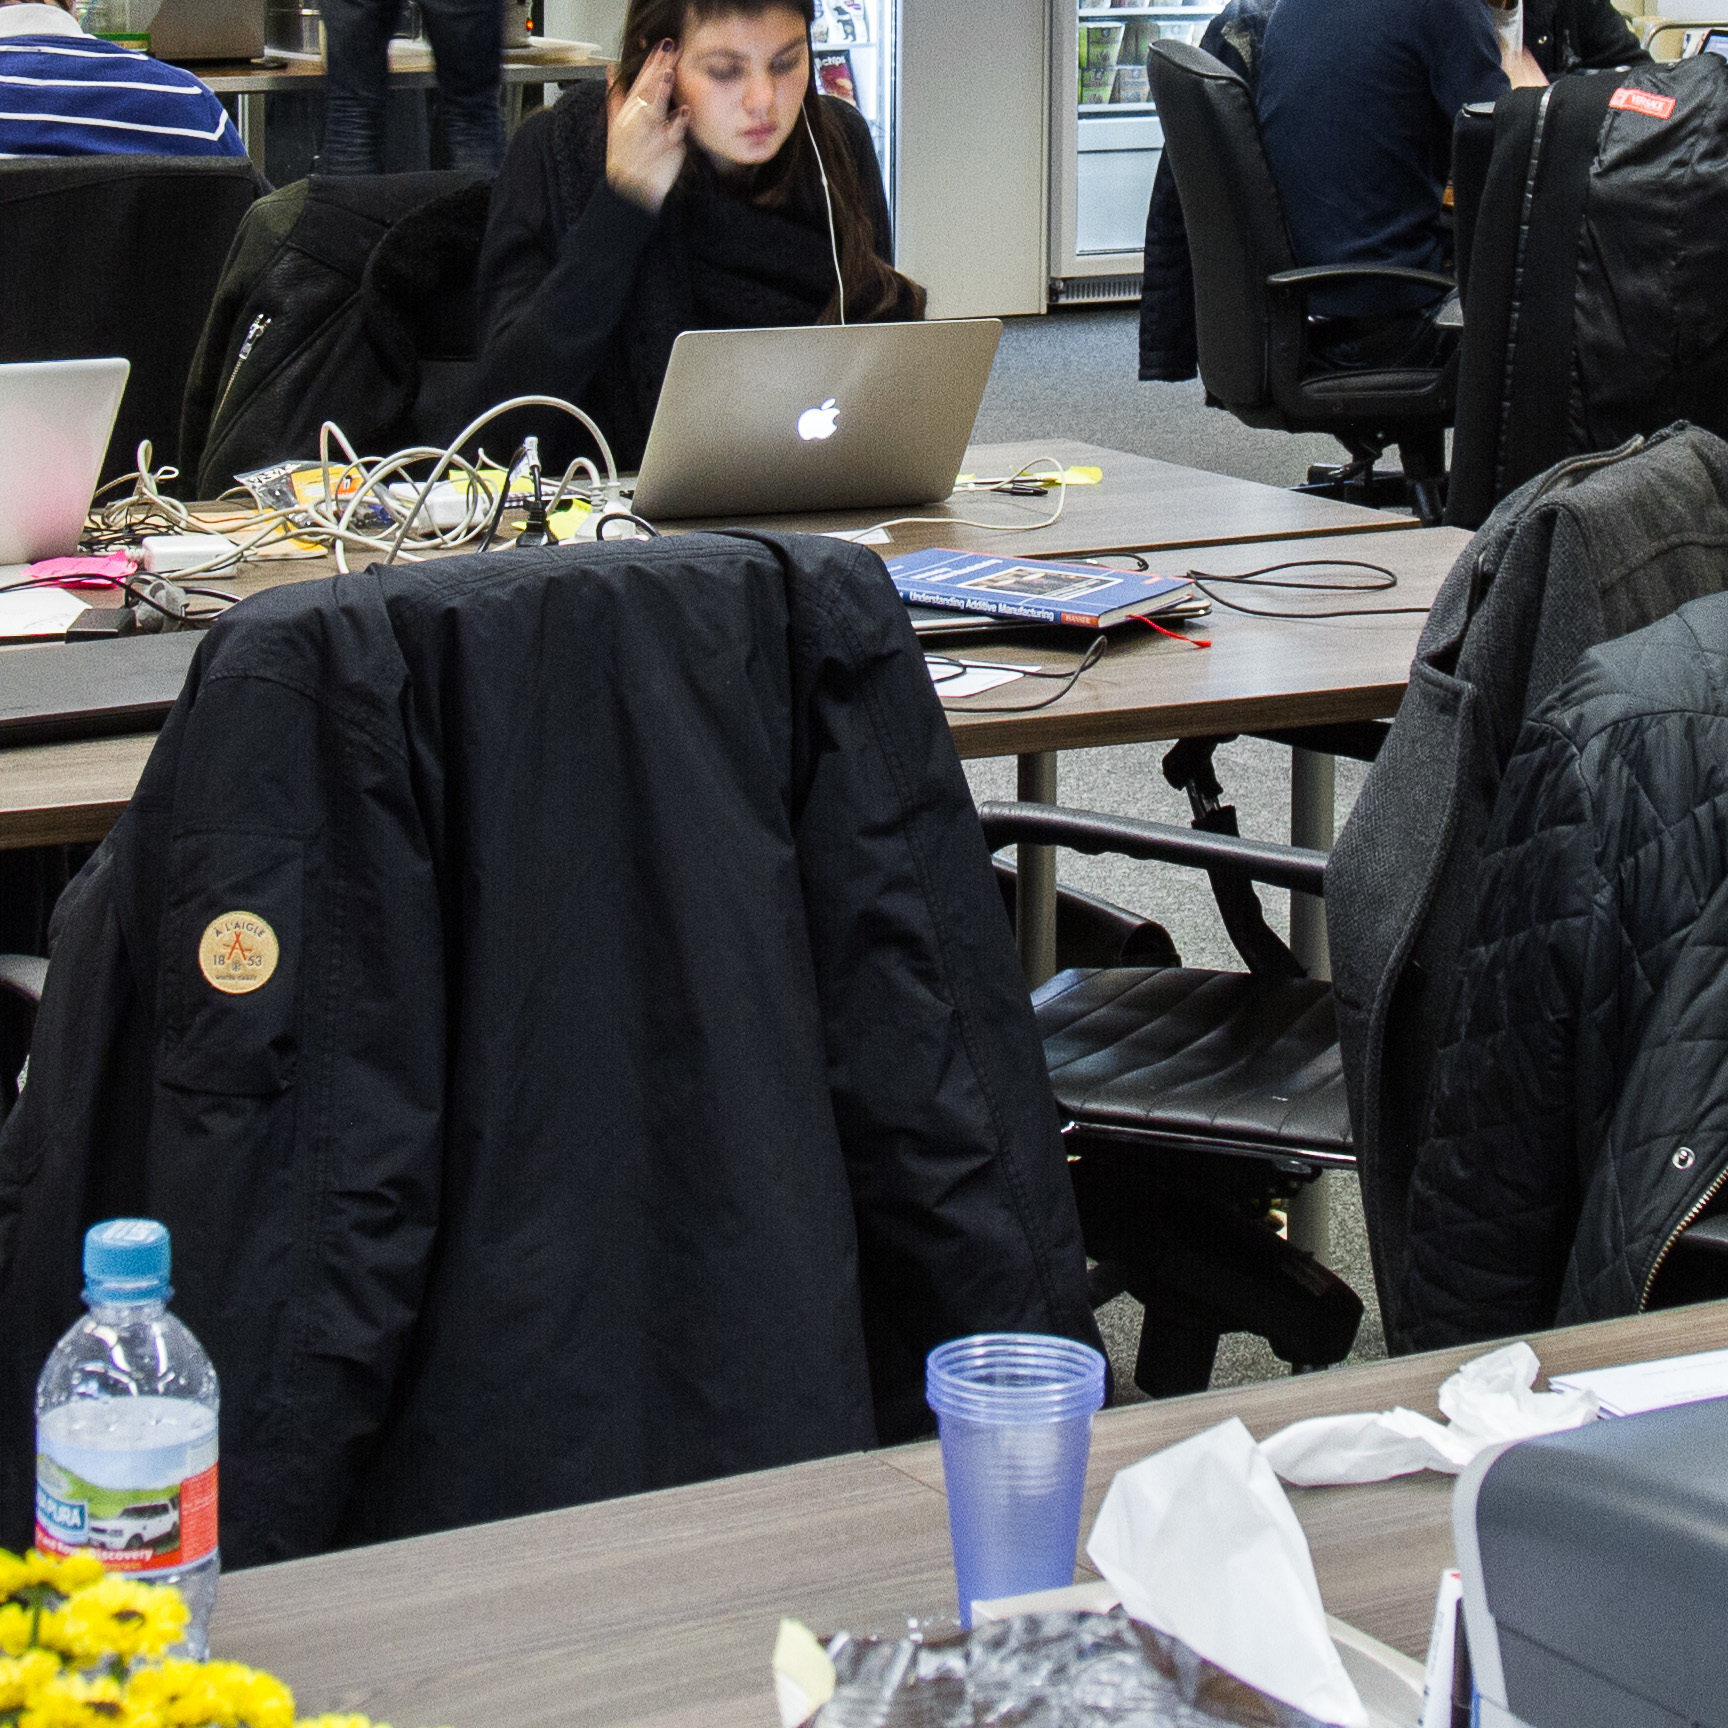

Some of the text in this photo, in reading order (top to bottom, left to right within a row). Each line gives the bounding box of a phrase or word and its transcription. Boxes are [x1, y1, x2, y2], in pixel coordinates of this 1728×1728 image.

[909, 591, 1055, 622] Understanding Additive Manufacturing
[224, 921, 265, 938] L'AIGLE
[213, 955, 262, 967] 18 53
